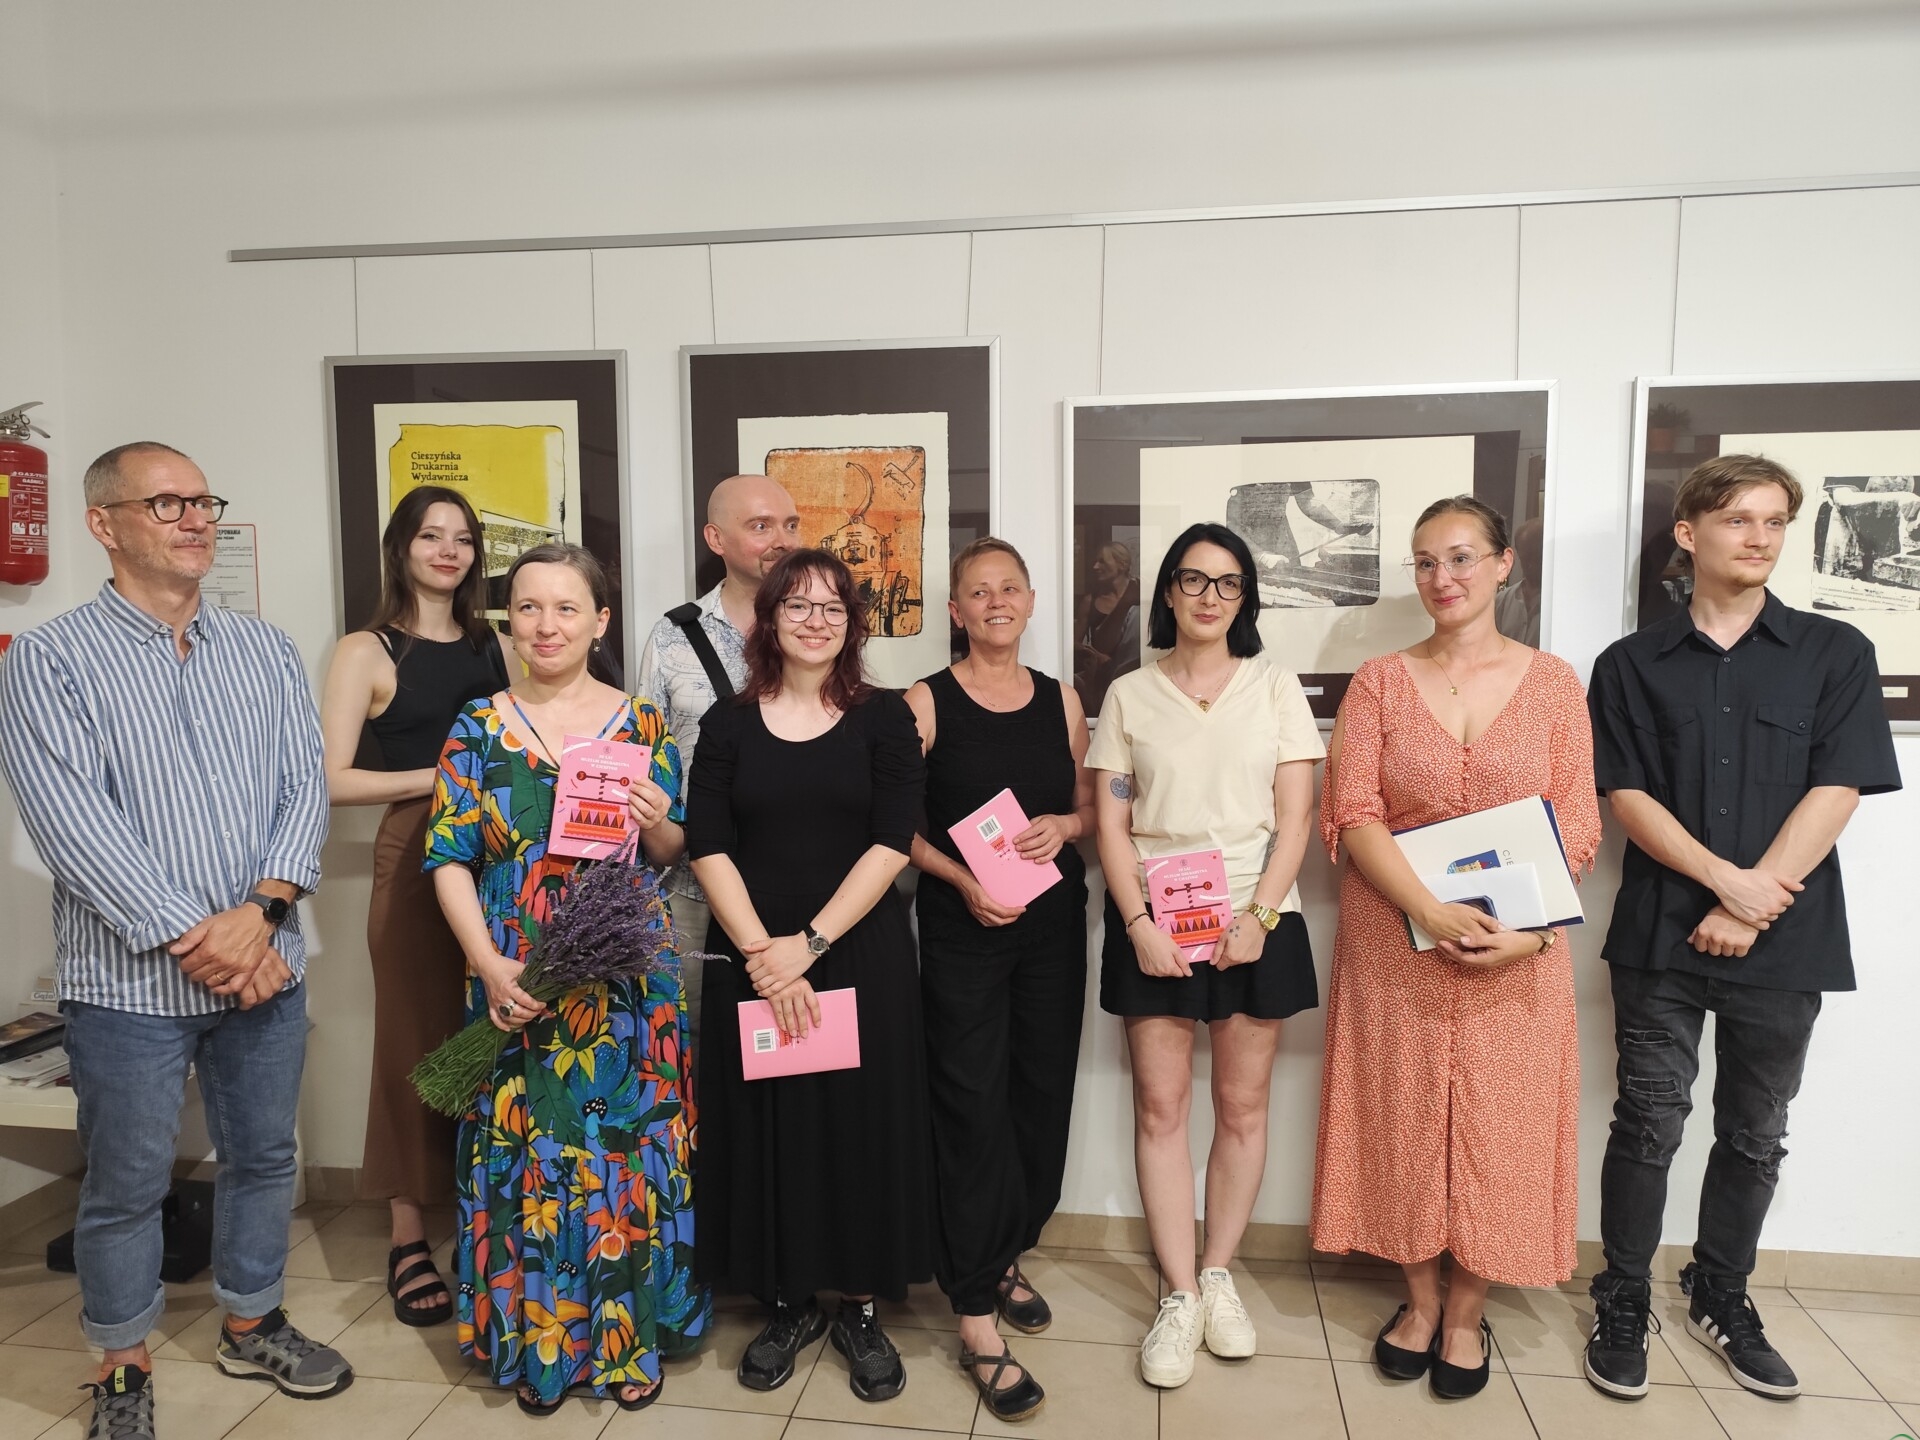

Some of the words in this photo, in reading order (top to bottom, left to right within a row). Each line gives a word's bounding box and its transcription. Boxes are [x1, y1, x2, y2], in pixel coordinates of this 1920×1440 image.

[411, 451, 461, 462] Cieszyńska
[411, 461, 459, 470] Drukarnia
[411, 472, 469, 483] Wydawnicza
[116, 1376, 123, 1385] S
